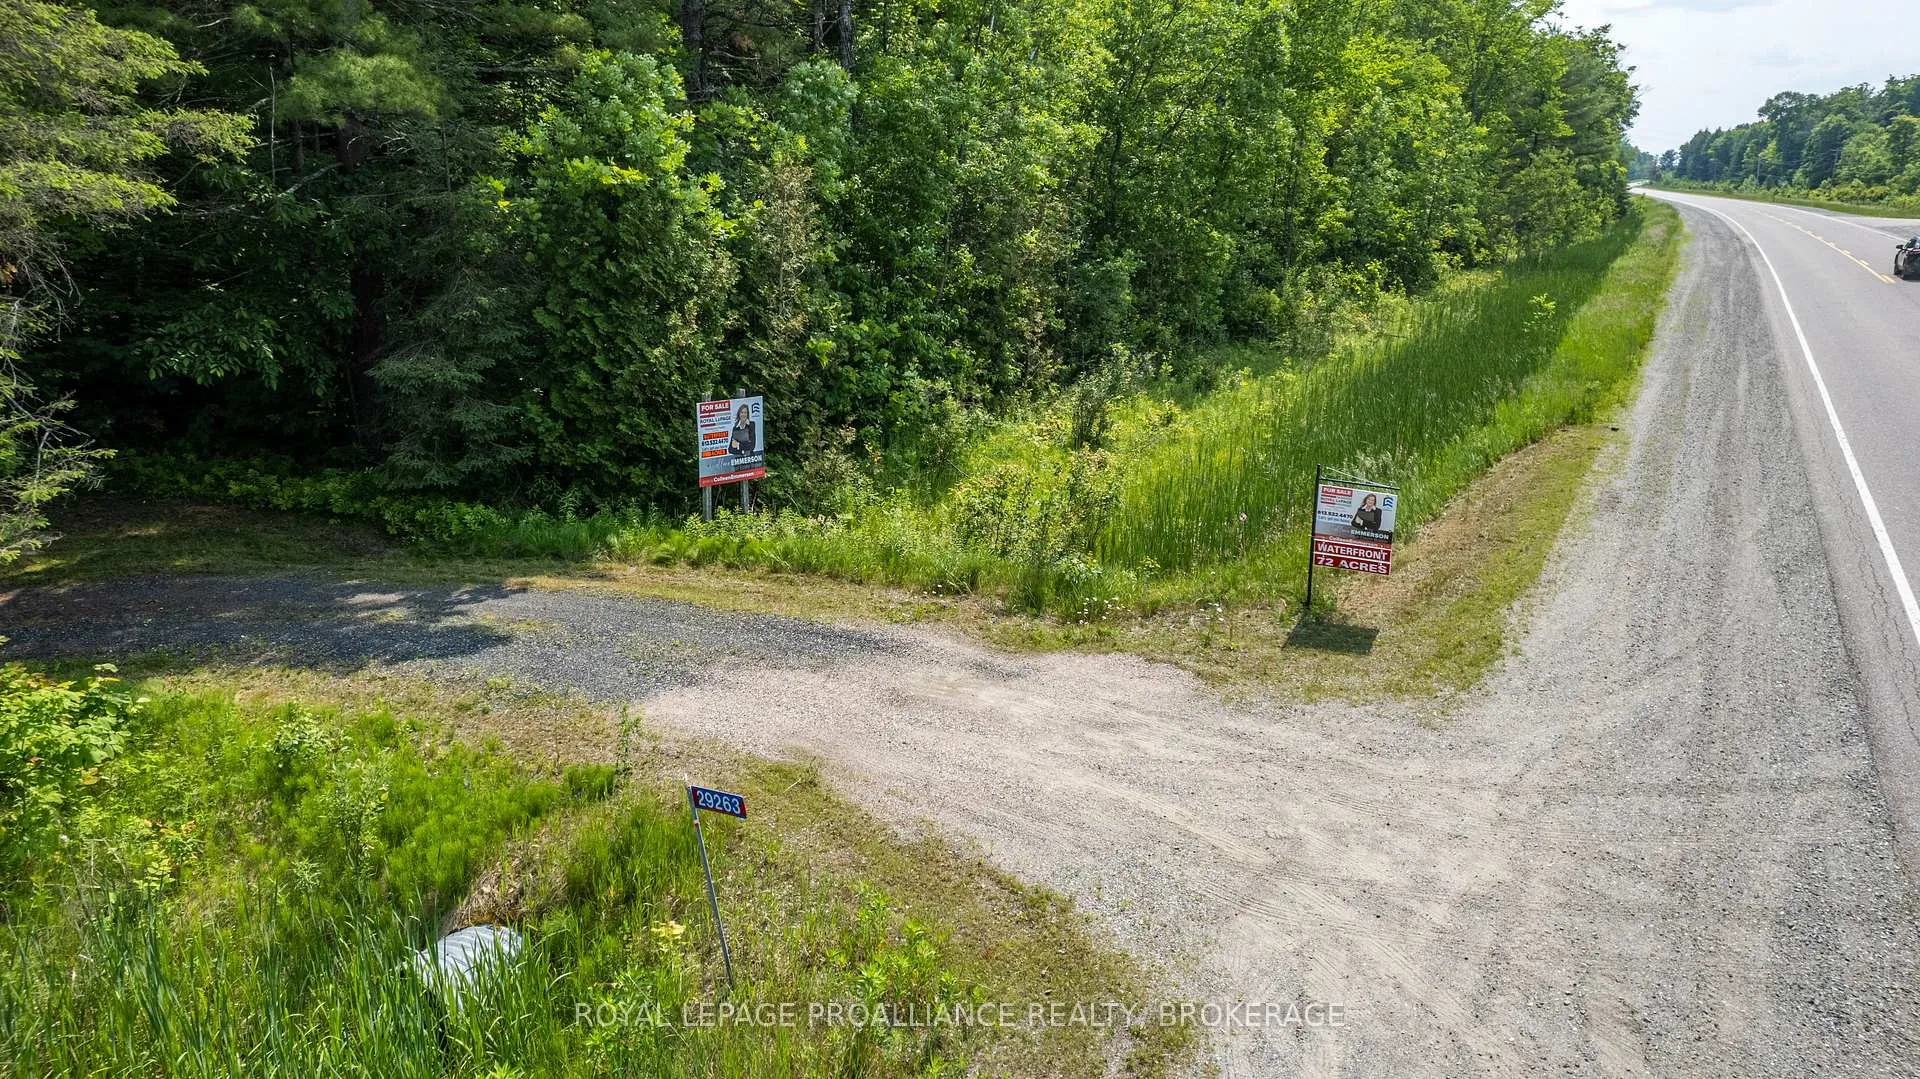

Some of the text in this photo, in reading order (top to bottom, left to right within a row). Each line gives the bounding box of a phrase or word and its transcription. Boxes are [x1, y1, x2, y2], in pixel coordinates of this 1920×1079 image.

[701, 402, 729, 412] FOR SALE
[731, 455, 762, 466] EMMERSON
[1351, 529, 1390, 540] EMMERSON
[1317, 542, 1388, 560] WATERFRONT
[1317, 556, 1388, 574] 72 ACRES
[697, 790, 741, 814] 29263
